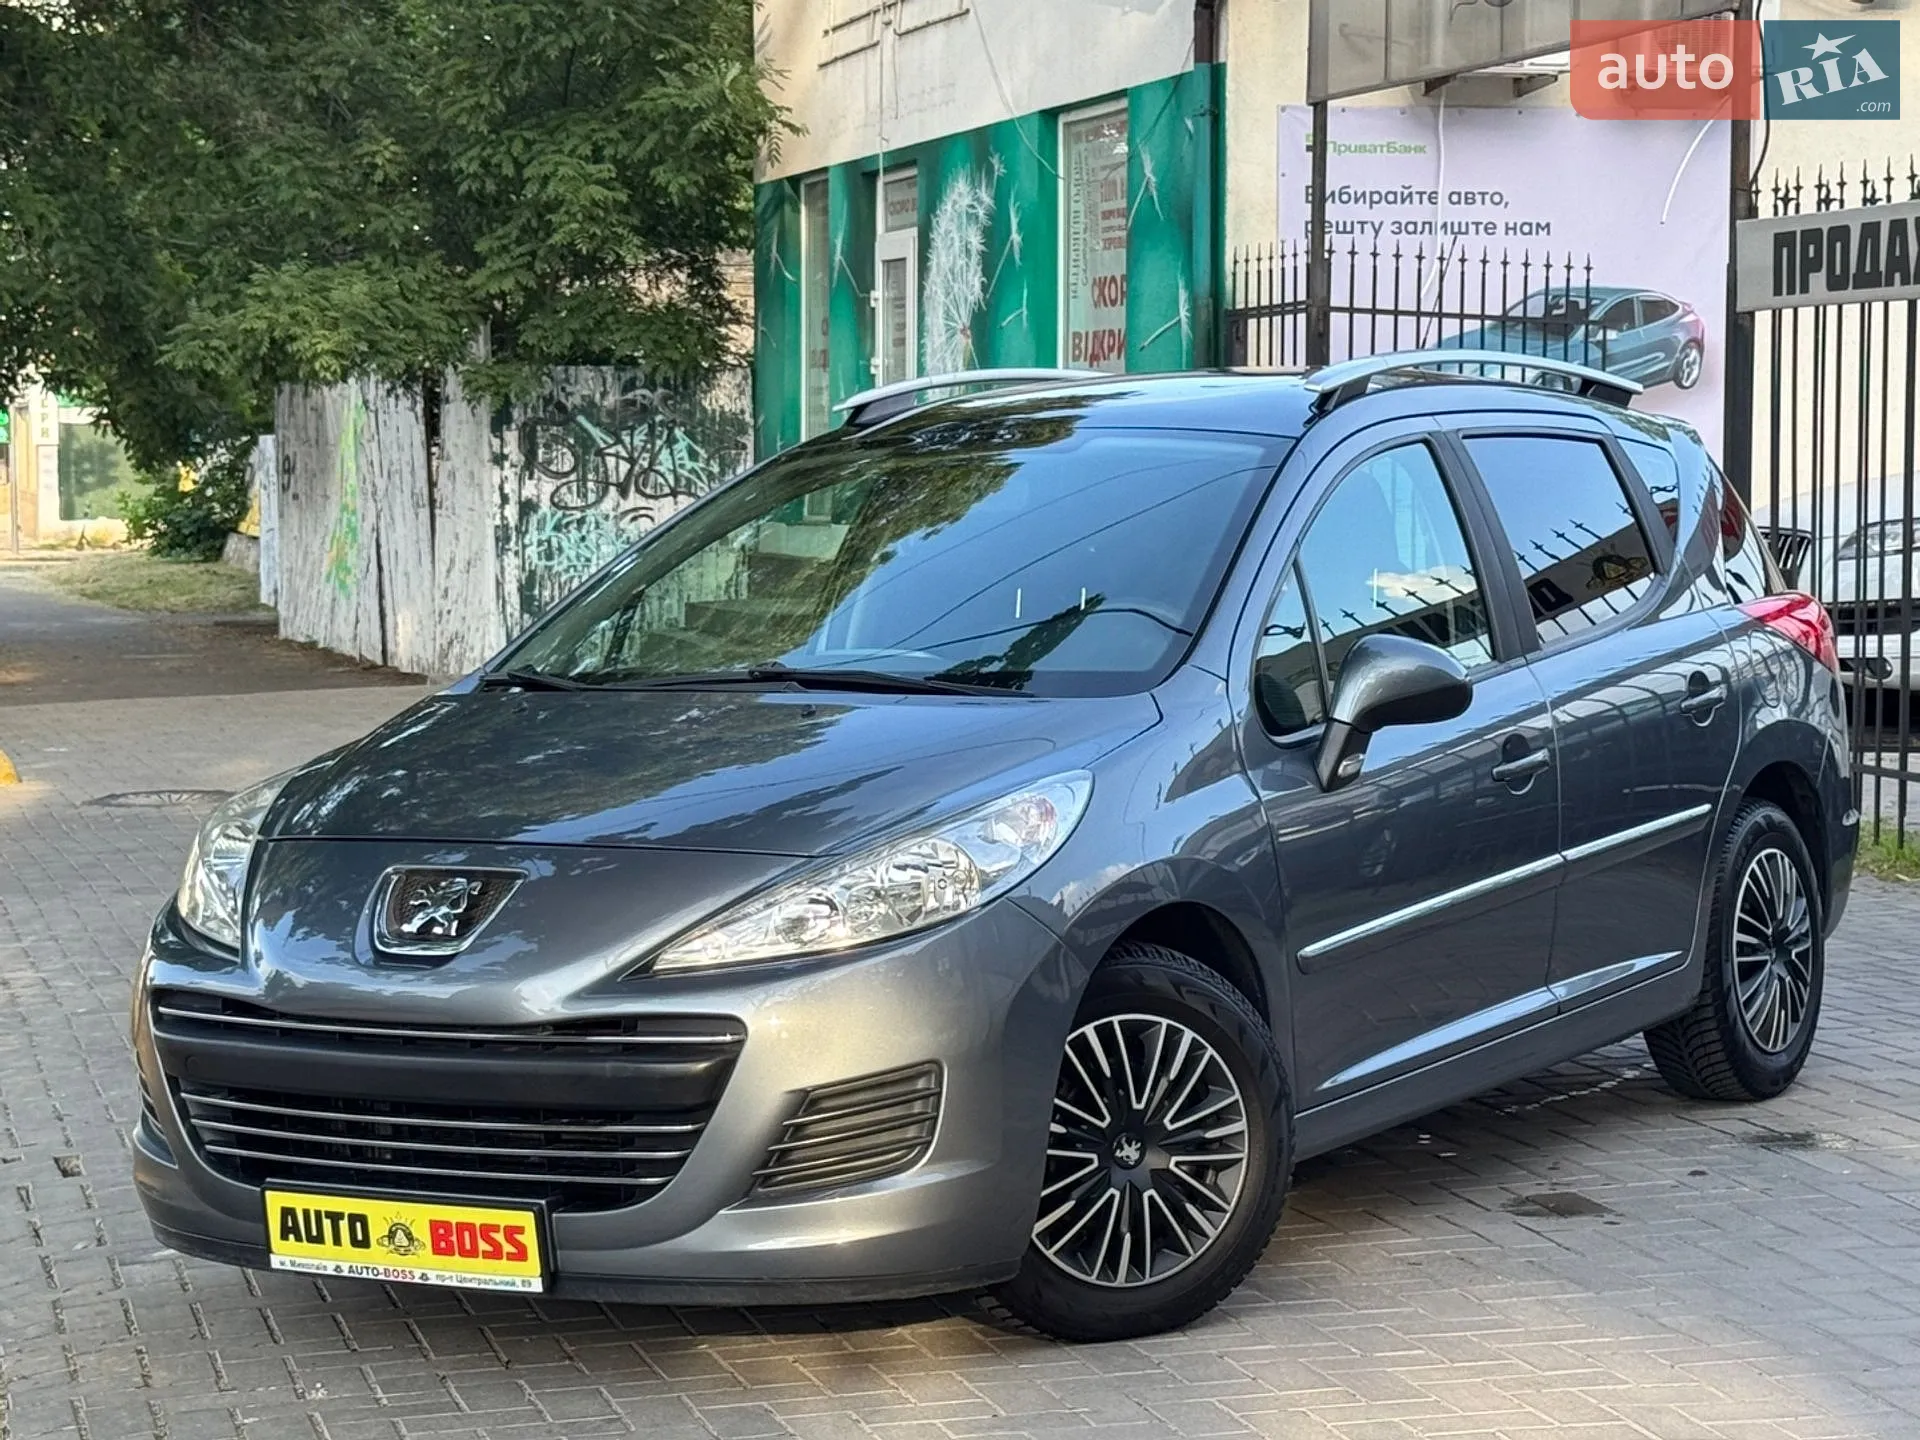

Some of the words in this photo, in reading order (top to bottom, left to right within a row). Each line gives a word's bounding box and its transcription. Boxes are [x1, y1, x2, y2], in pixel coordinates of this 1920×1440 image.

[1447, 191, 1509, 209] авто,
[1504, 221, 1551, 236] нам
[1772, 215, 1920, 297] ПРОДА
[280, 1206, 371, 1249] AUTO
[429, 1219, 529, 1262] BOSS
[347, 1264, 416, 1281] AUTO-BOSS
